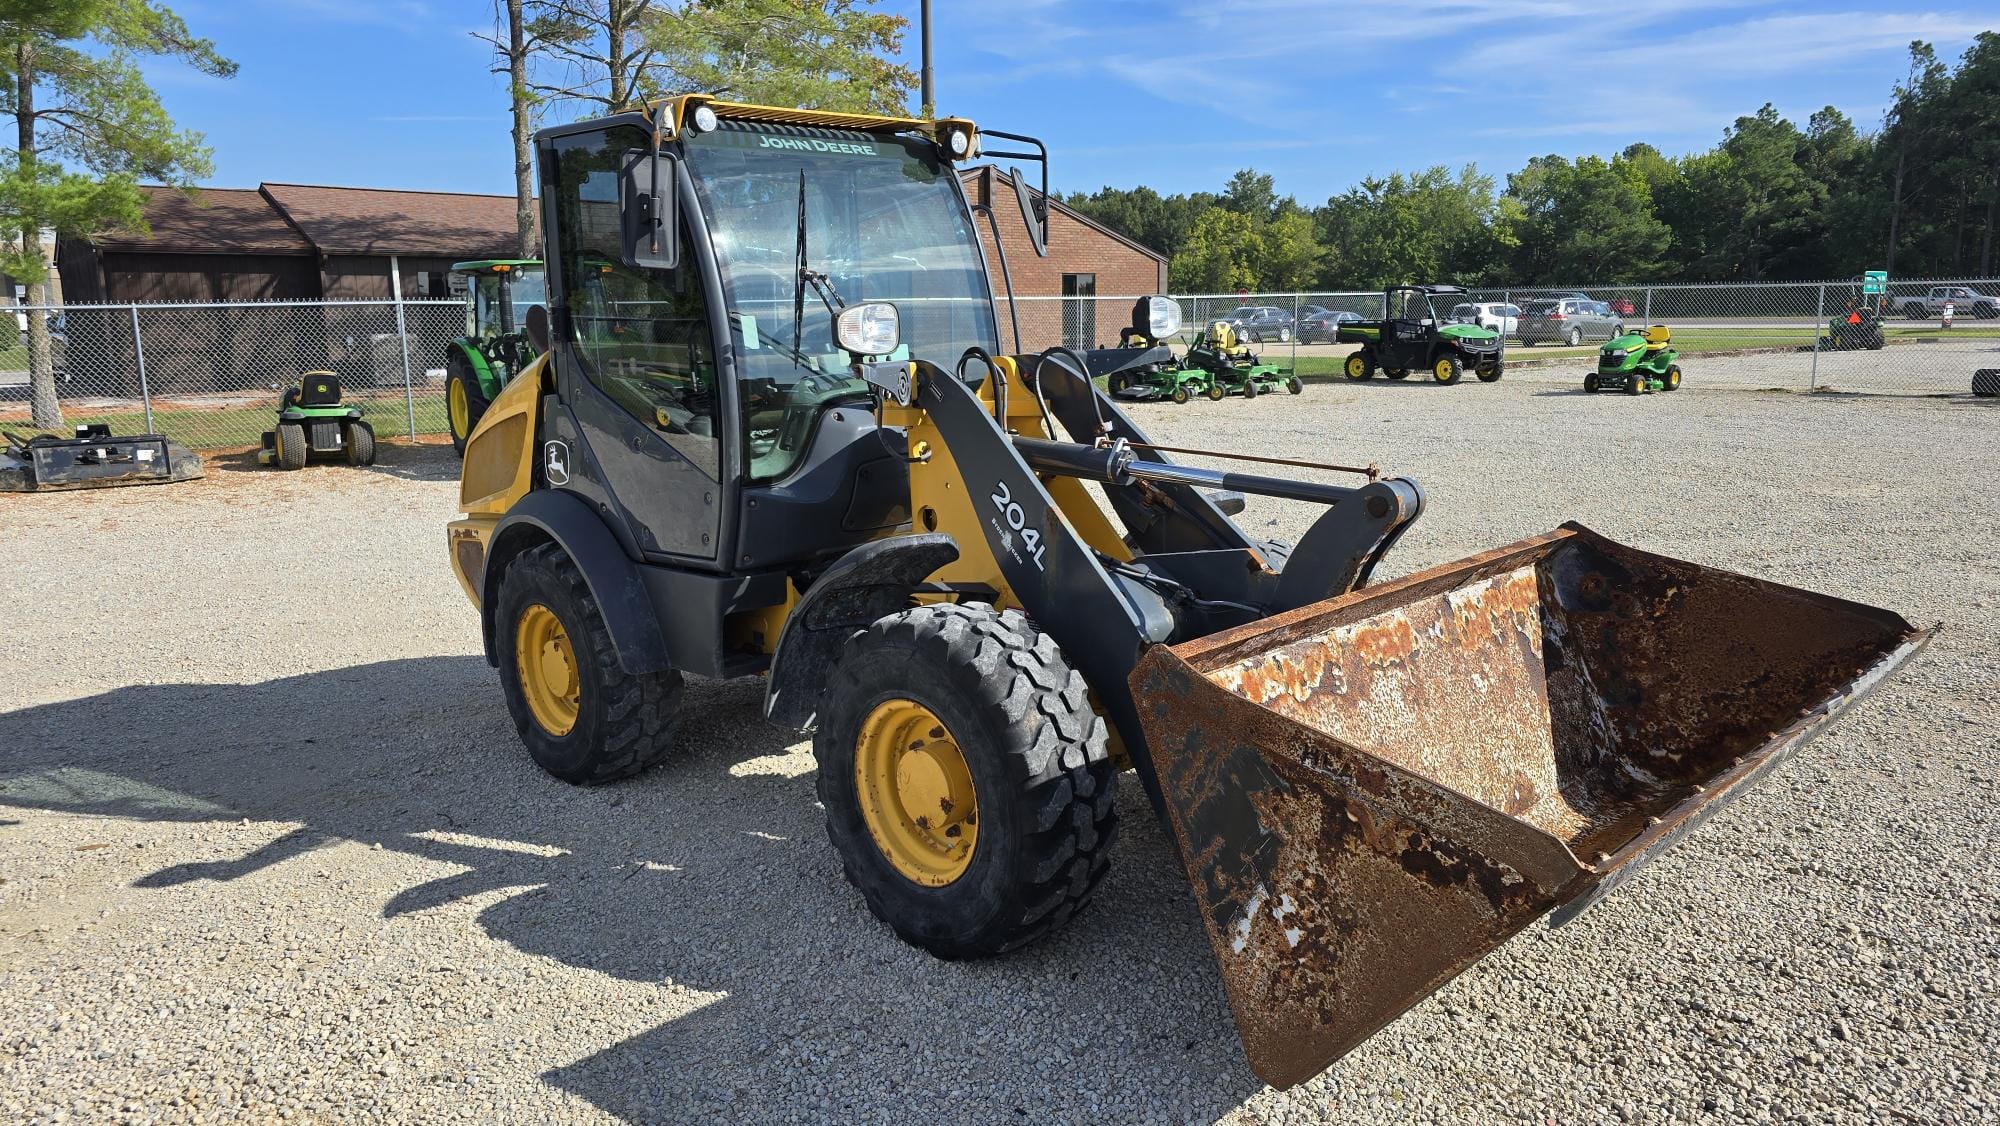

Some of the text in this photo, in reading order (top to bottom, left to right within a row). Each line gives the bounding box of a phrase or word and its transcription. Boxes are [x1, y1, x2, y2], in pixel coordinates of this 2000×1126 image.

[759, 135, 877, 155] JOHN DEERE
[991, 481, 1046, 572] 204L
